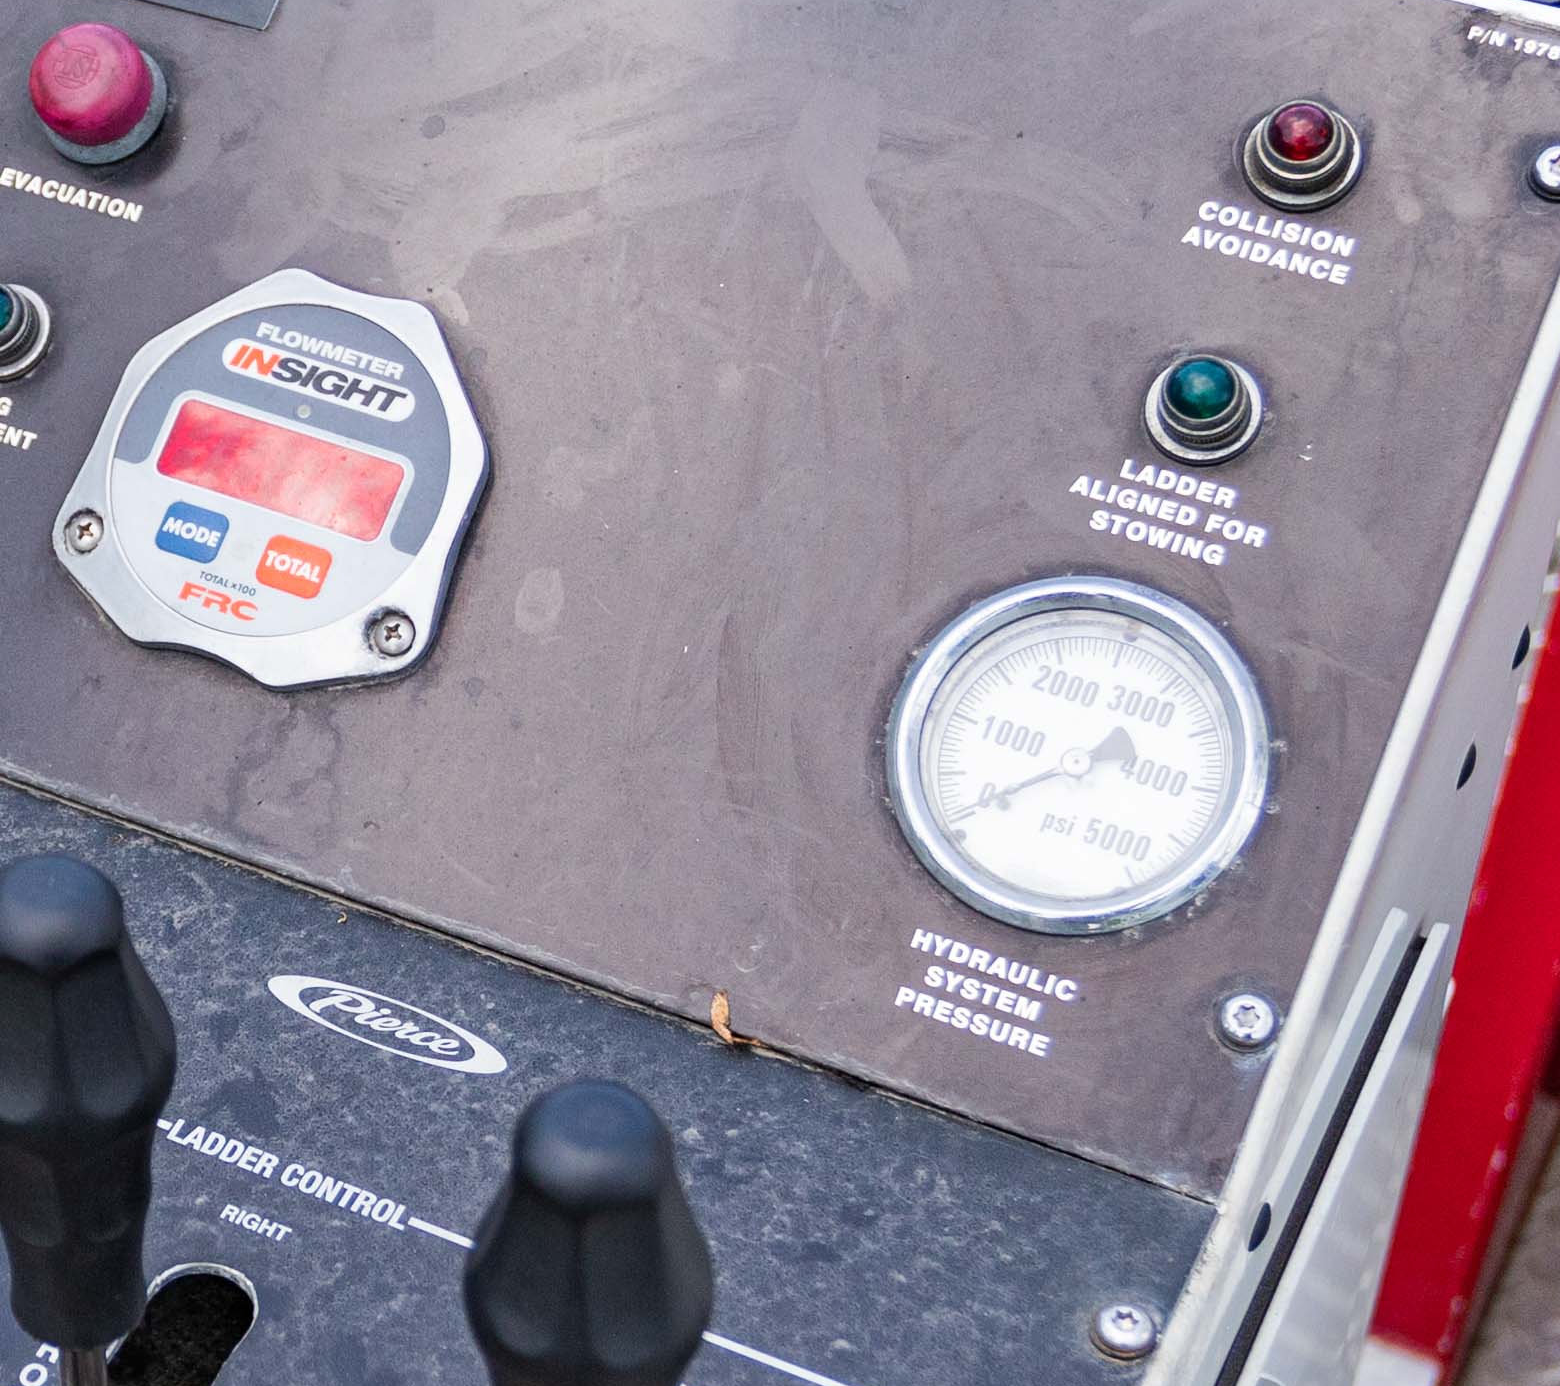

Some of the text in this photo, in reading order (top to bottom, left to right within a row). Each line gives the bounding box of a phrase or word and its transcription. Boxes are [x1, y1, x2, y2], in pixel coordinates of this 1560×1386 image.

[1466, 24, 1508, 47] P/N
[1198, 201, 1354, 256] COLLISION
[1181, 226, 1349, 284] AVOIDANCE
[254, 322, 403, 379] FLOWMETER
[226, 345, 409, 411] INSIGHT
[1119, 459, 1236, 508] LADDER
[162, 516, 221, 547] MODE
[1069, 475, 1266, 547] ALIGNED FOR
[1089, 509, 1224, 565] STOWING
[198, 570, 229, 588] TOTAL
[265, 549, 320, 583] TOTAL
[178, 581, 257, 621] FRC
[1031, 663, 1100, 707] 2000
[1106, 684, 1175, 727] 3000
[982, 715, 1046, 757] 1000
[1119, 748, 1188, 797] 4000
[1039, 812, 1077, 836] psi
[1082, 817, 1151, 862] 5000
[911, 929, 1076, 1000] HYDRAULIC
[924, 965, 1041, 1020] SYSTEM
[894, 986, 1049, 1056] PRESSURE
[167, 1118, 406, 1230] LADDER CONTROL
[219, 1203, 292, 1241] RIGHT
